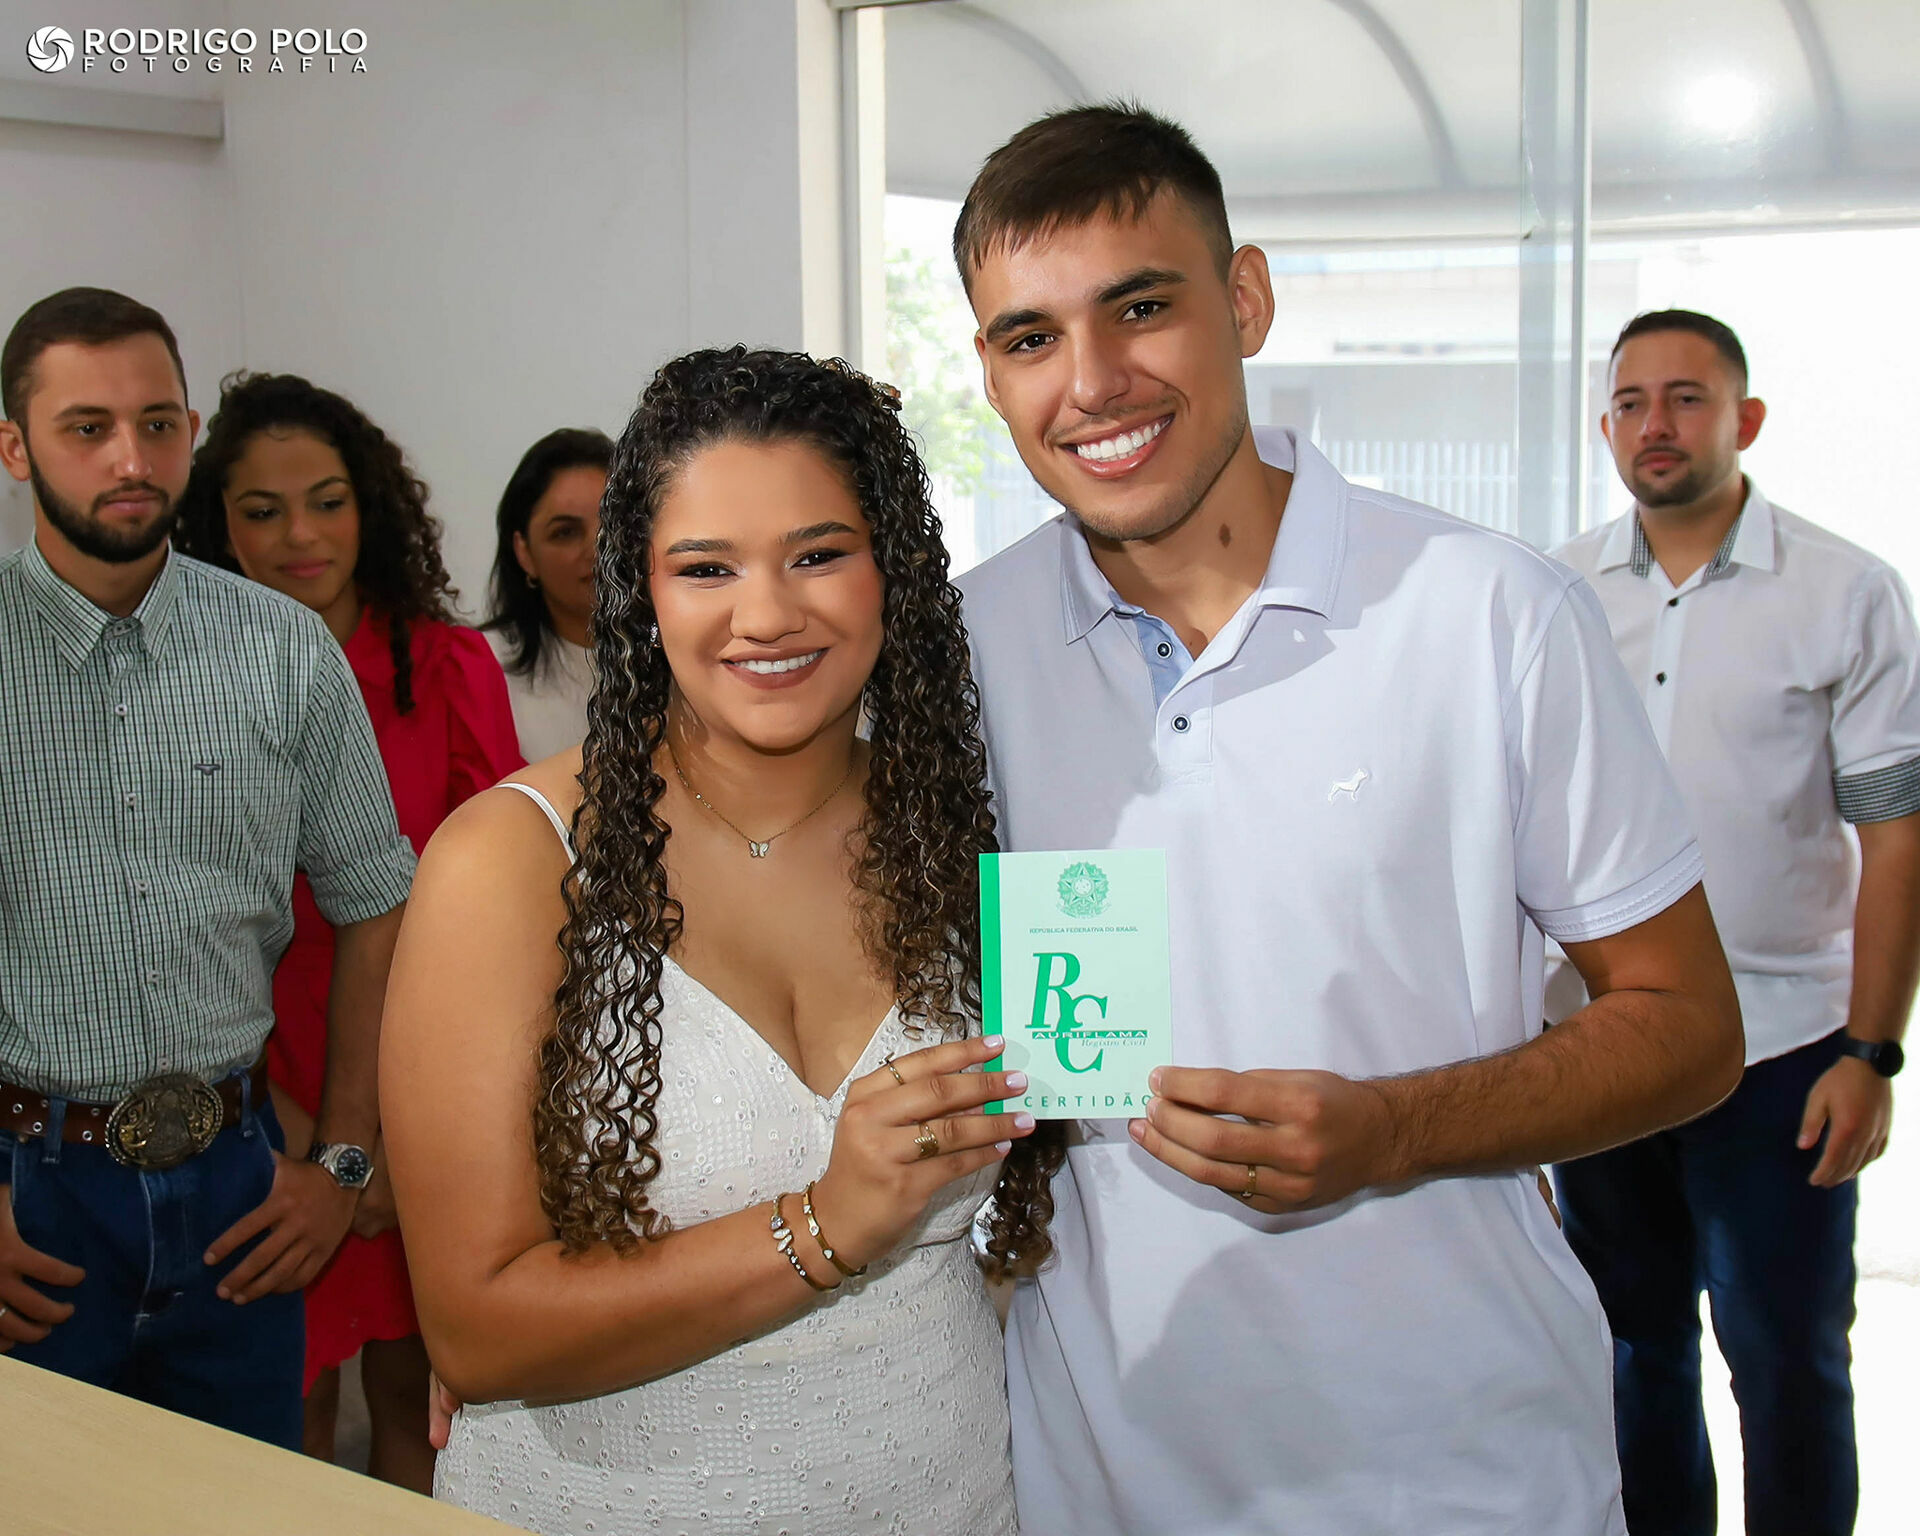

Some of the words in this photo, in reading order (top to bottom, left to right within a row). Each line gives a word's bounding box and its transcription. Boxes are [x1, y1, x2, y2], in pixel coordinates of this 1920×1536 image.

[1033, 1030, 1147, 1039] AURIFLAMA
[1081, 1038, 1120, 1048] Registro
[1122, 1038, 1147, 1047] Civil
